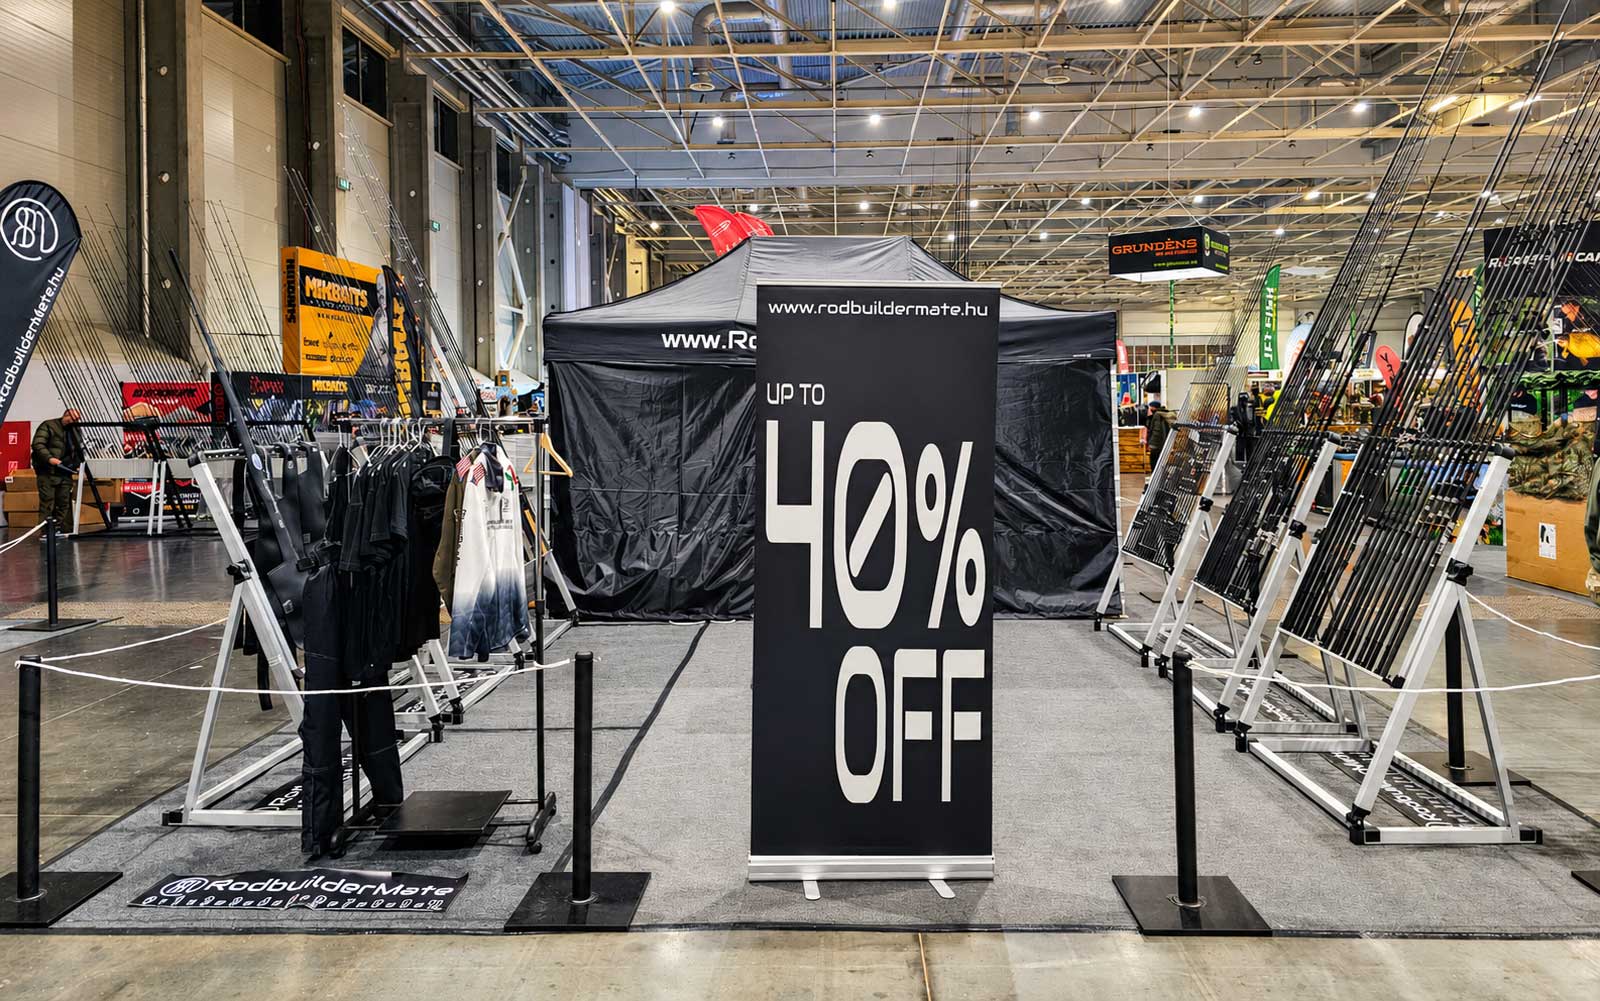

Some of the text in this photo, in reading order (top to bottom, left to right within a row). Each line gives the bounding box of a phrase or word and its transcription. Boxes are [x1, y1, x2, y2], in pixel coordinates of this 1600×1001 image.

[768, 300, 989, 317] www.rodbuildermate.hu
[766, 382, 826, 405] UP TO
[766, 420, 986, 629] 40%
[835, 646, 985, 803] OFF
[205, 875, 455, 896] RodbuilderMate
